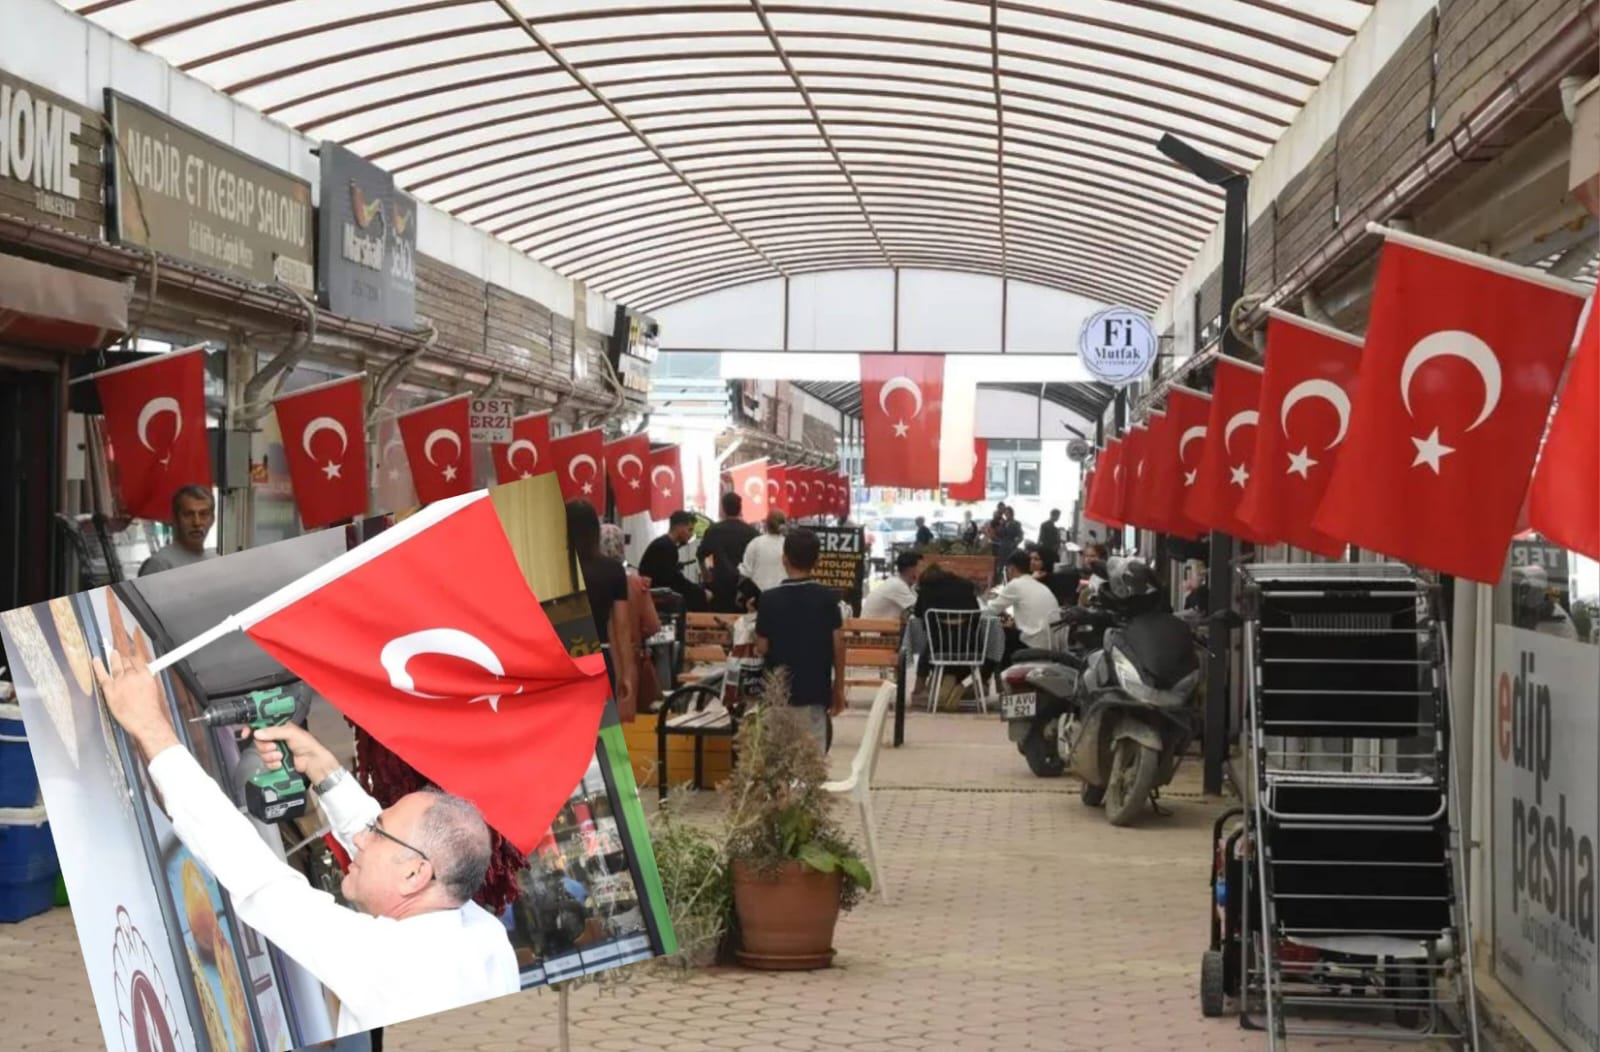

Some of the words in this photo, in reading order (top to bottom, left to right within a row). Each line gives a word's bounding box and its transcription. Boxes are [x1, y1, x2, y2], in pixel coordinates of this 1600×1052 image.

[128, 128, 181, 199] NADİR
[185, 154, 204, 209] ET
[207, 163, 255, 226] KEBAP
[258, 186, 306, 248] SALONU
[1095, 347, 1141, 359] Mutfak
[1103, 319, 1132, 346] Fi
[472, 400, 513, 413] OST
[1499, 651, 1551, 806] edip
[1512, 793, 1594, 944] pasha
